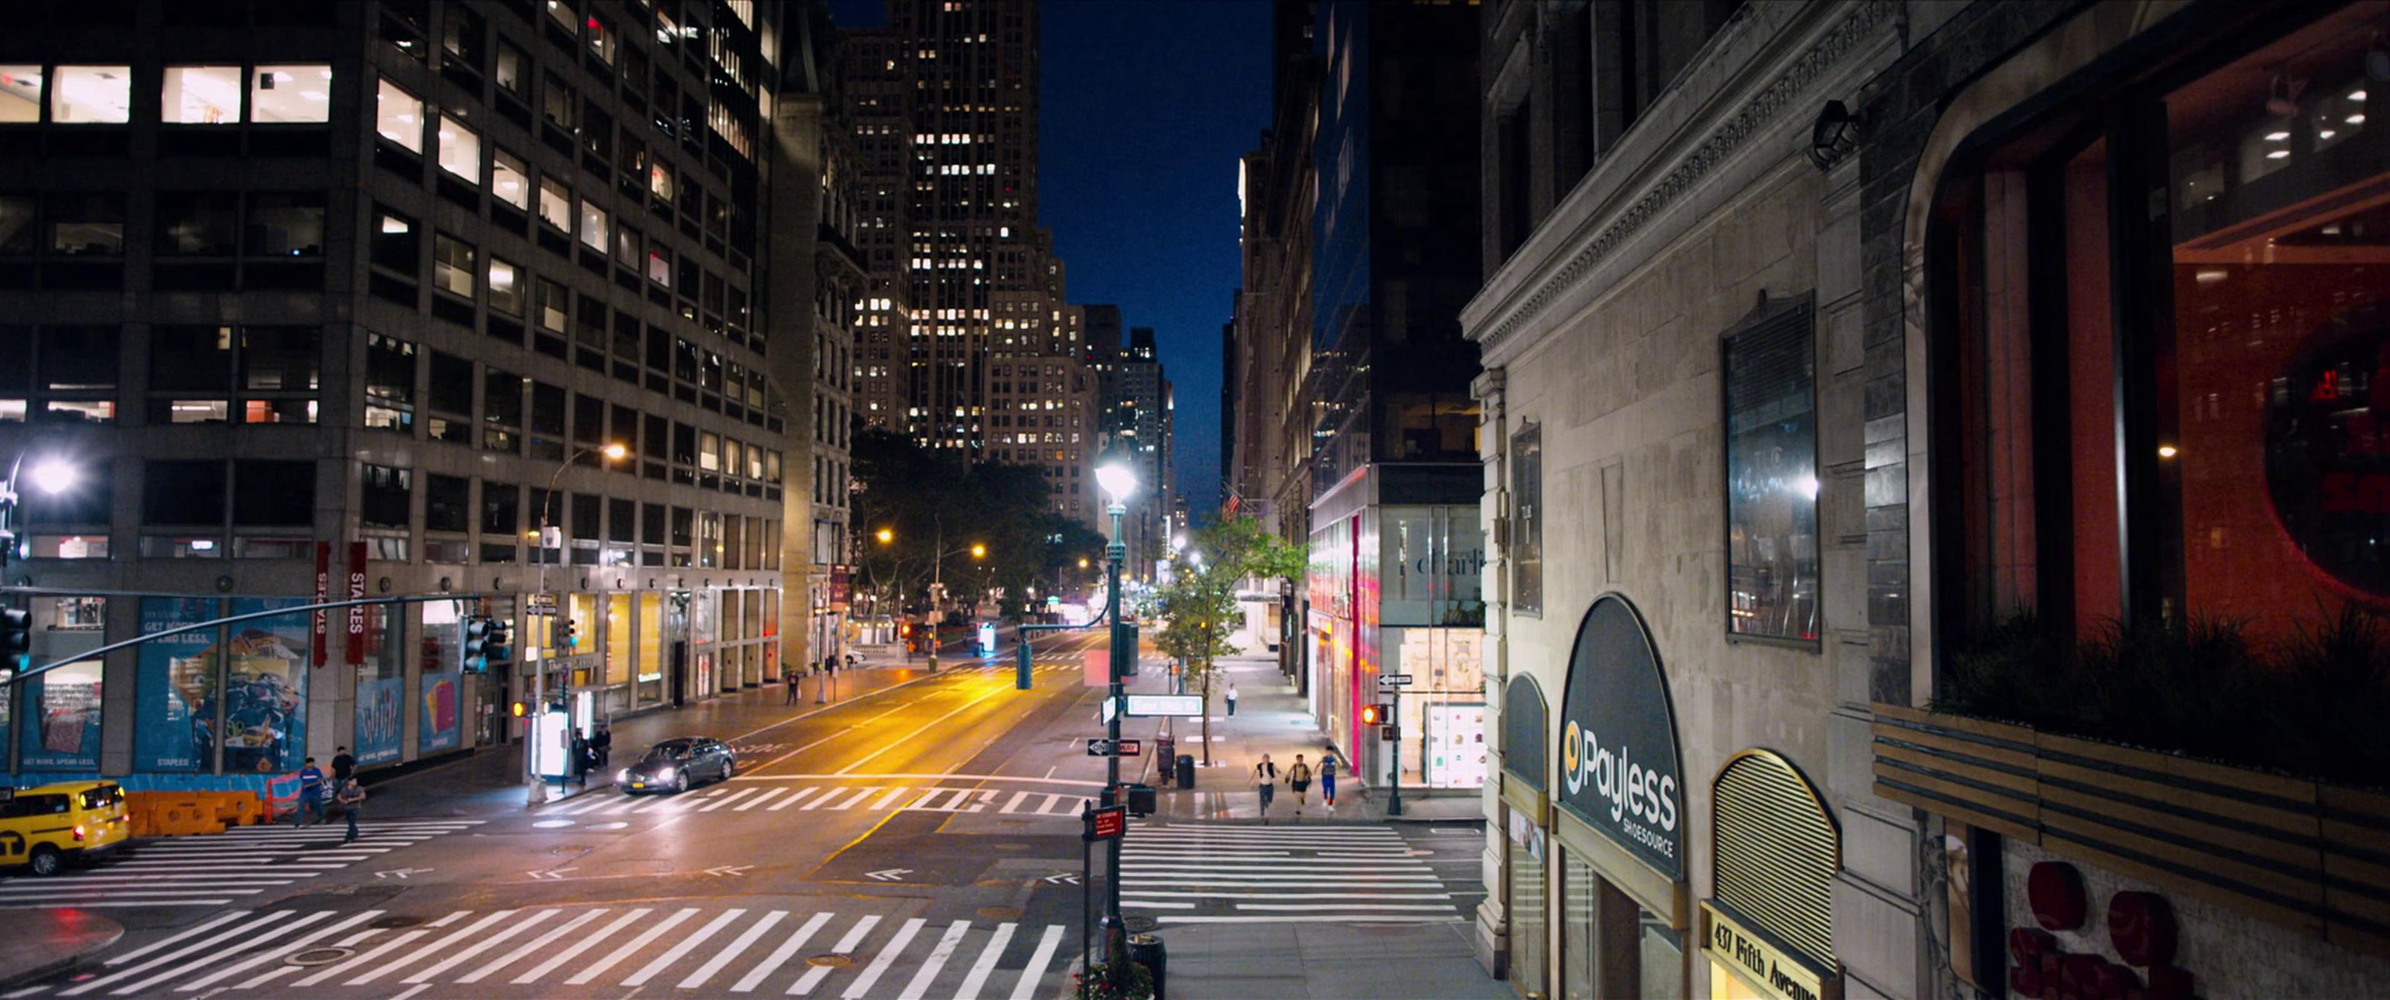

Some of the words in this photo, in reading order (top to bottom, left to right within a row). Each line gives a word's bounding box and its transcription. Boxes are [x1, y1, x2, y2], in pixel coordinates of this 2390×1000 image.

[1583, 729, 1676, 832] Payless
[1623, 817, 1674, 859] SHOESOURCE
[1714, 922, 1732, 953] 437
[1735, 933, 1765, 978] Fifth
